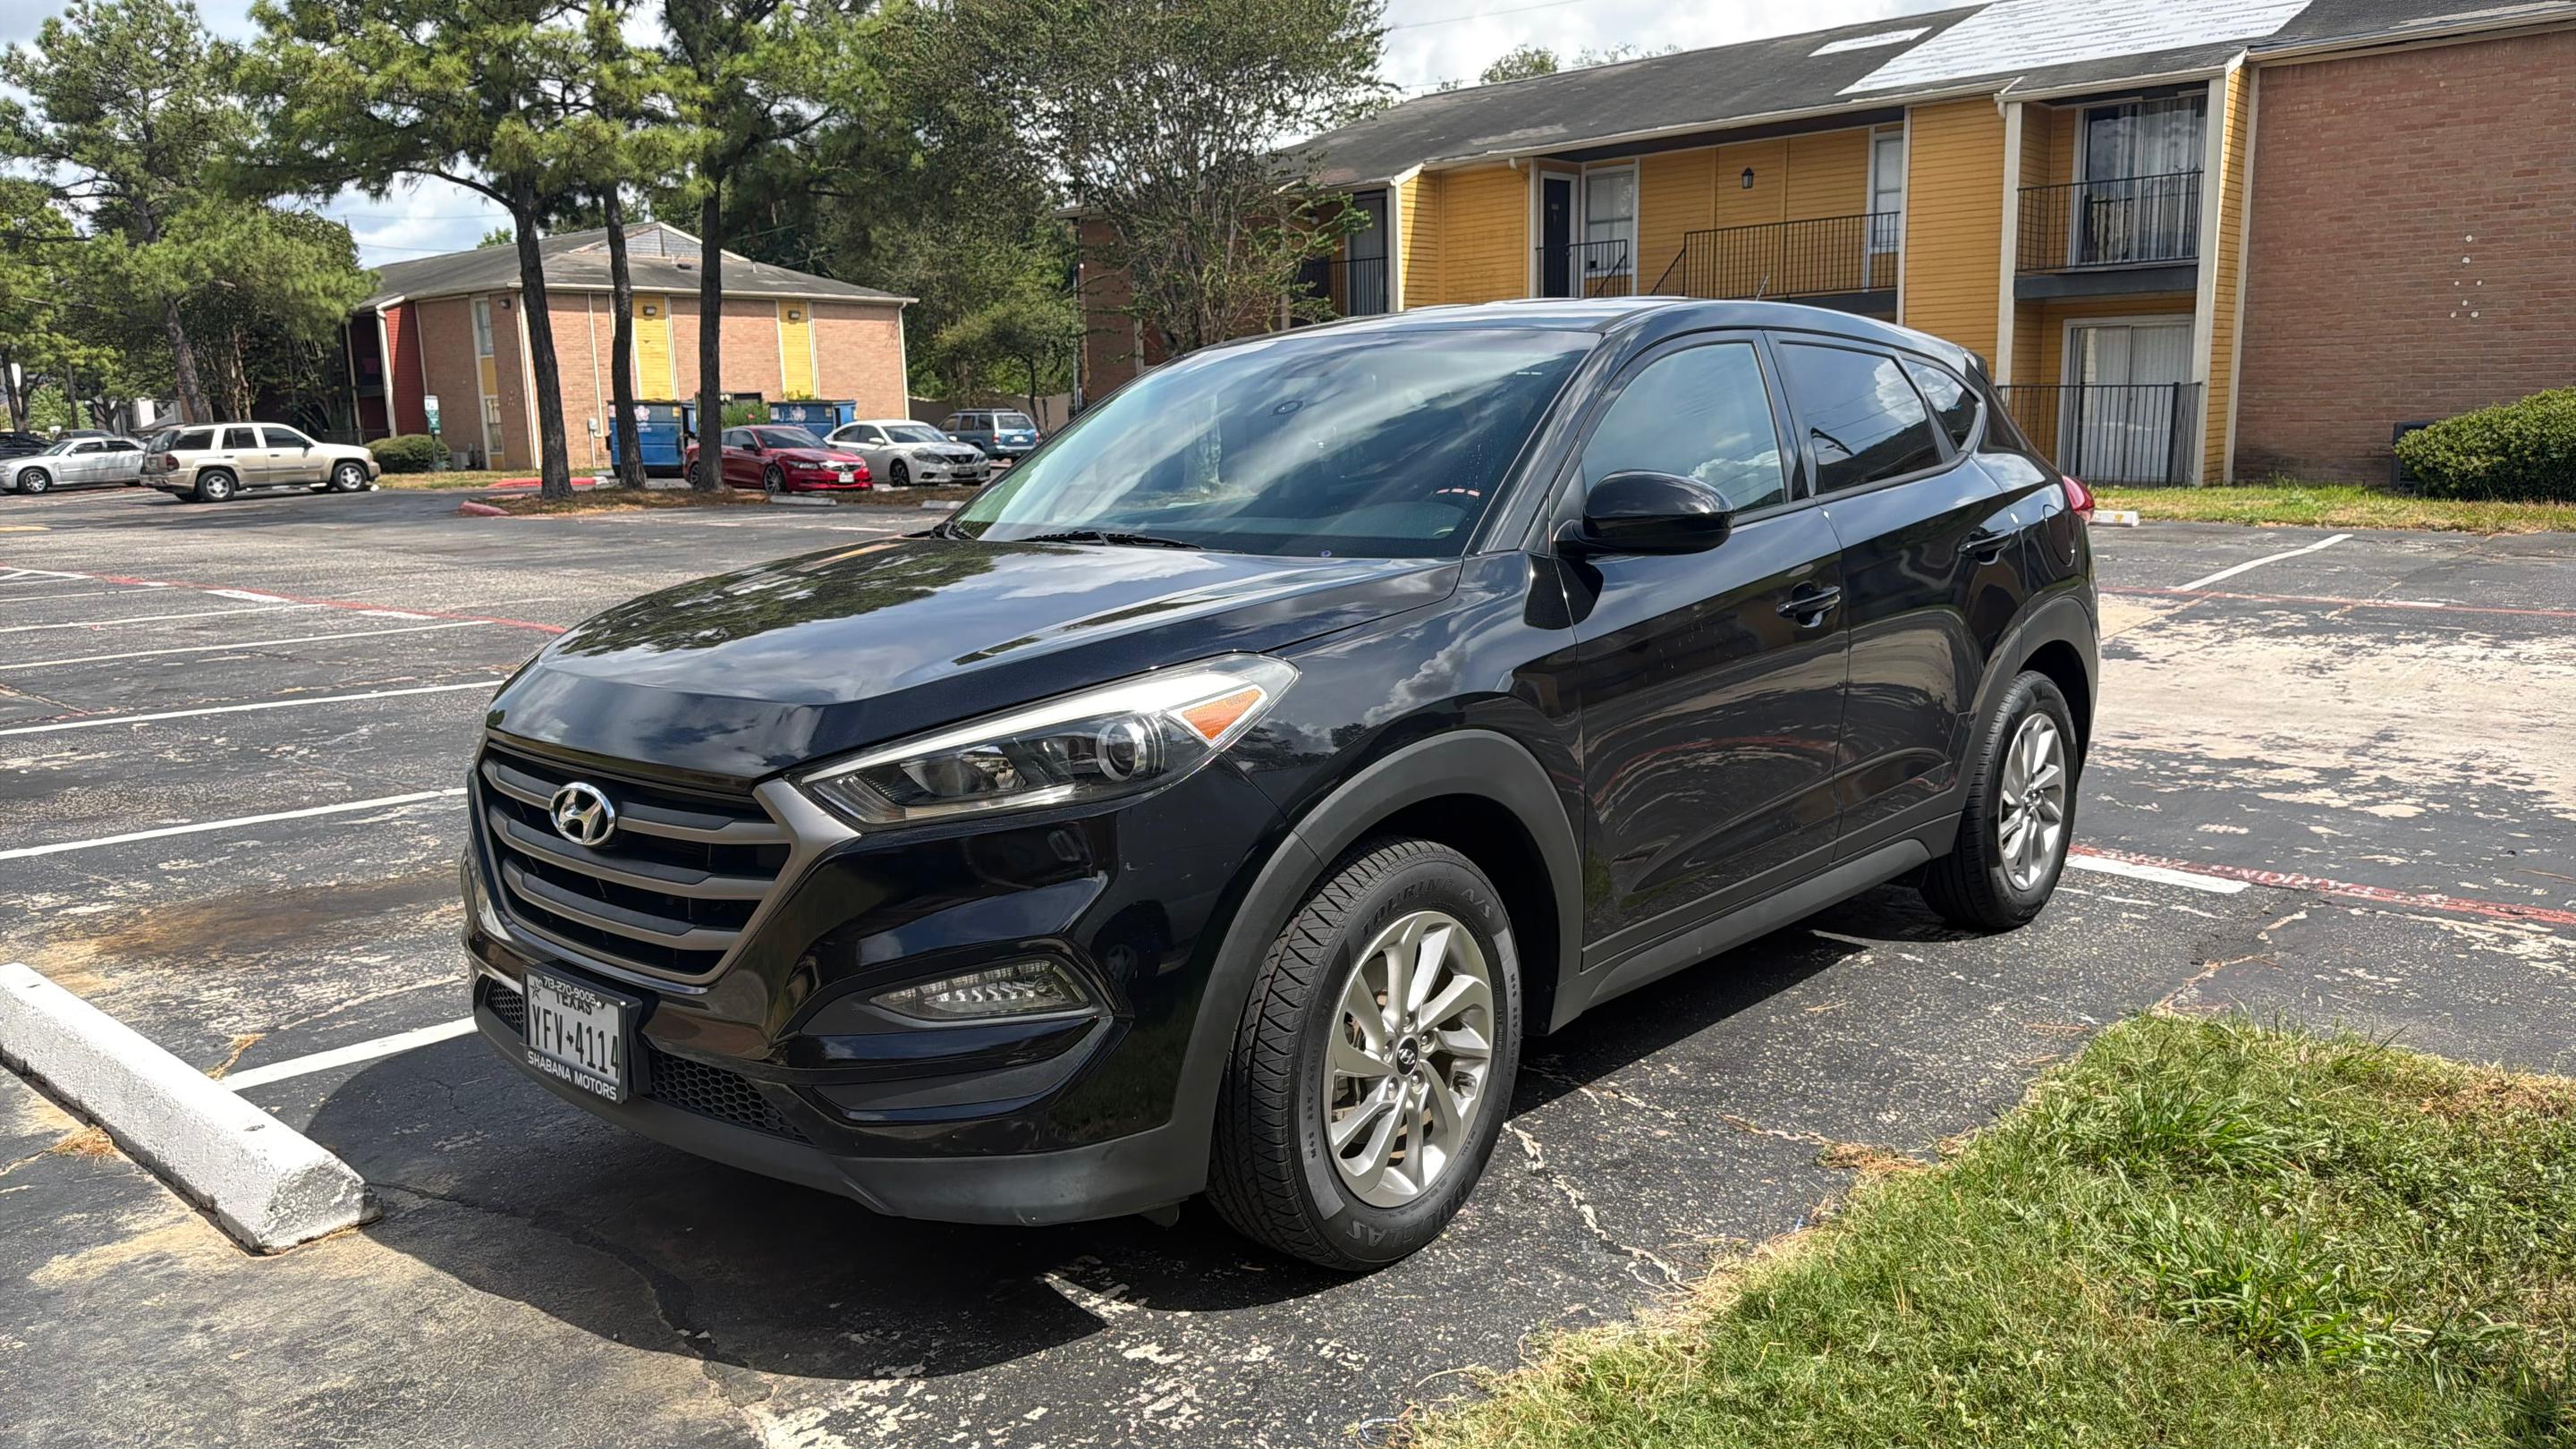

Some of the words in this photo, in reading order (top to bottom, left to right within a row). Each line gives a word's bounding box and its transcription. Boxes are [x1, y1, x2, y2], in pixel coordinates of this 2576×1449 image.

[1460, 887, 1491, 919] A/S
[555, 993, 592, 1016] TEXAS
[531, 1004, 564, 1055] YFV
[574, 1021, 620, 1080] 4114
[528, 1051, 572, 1082] SHABANA
[574, 1071, 617, 1101] MOTORS
